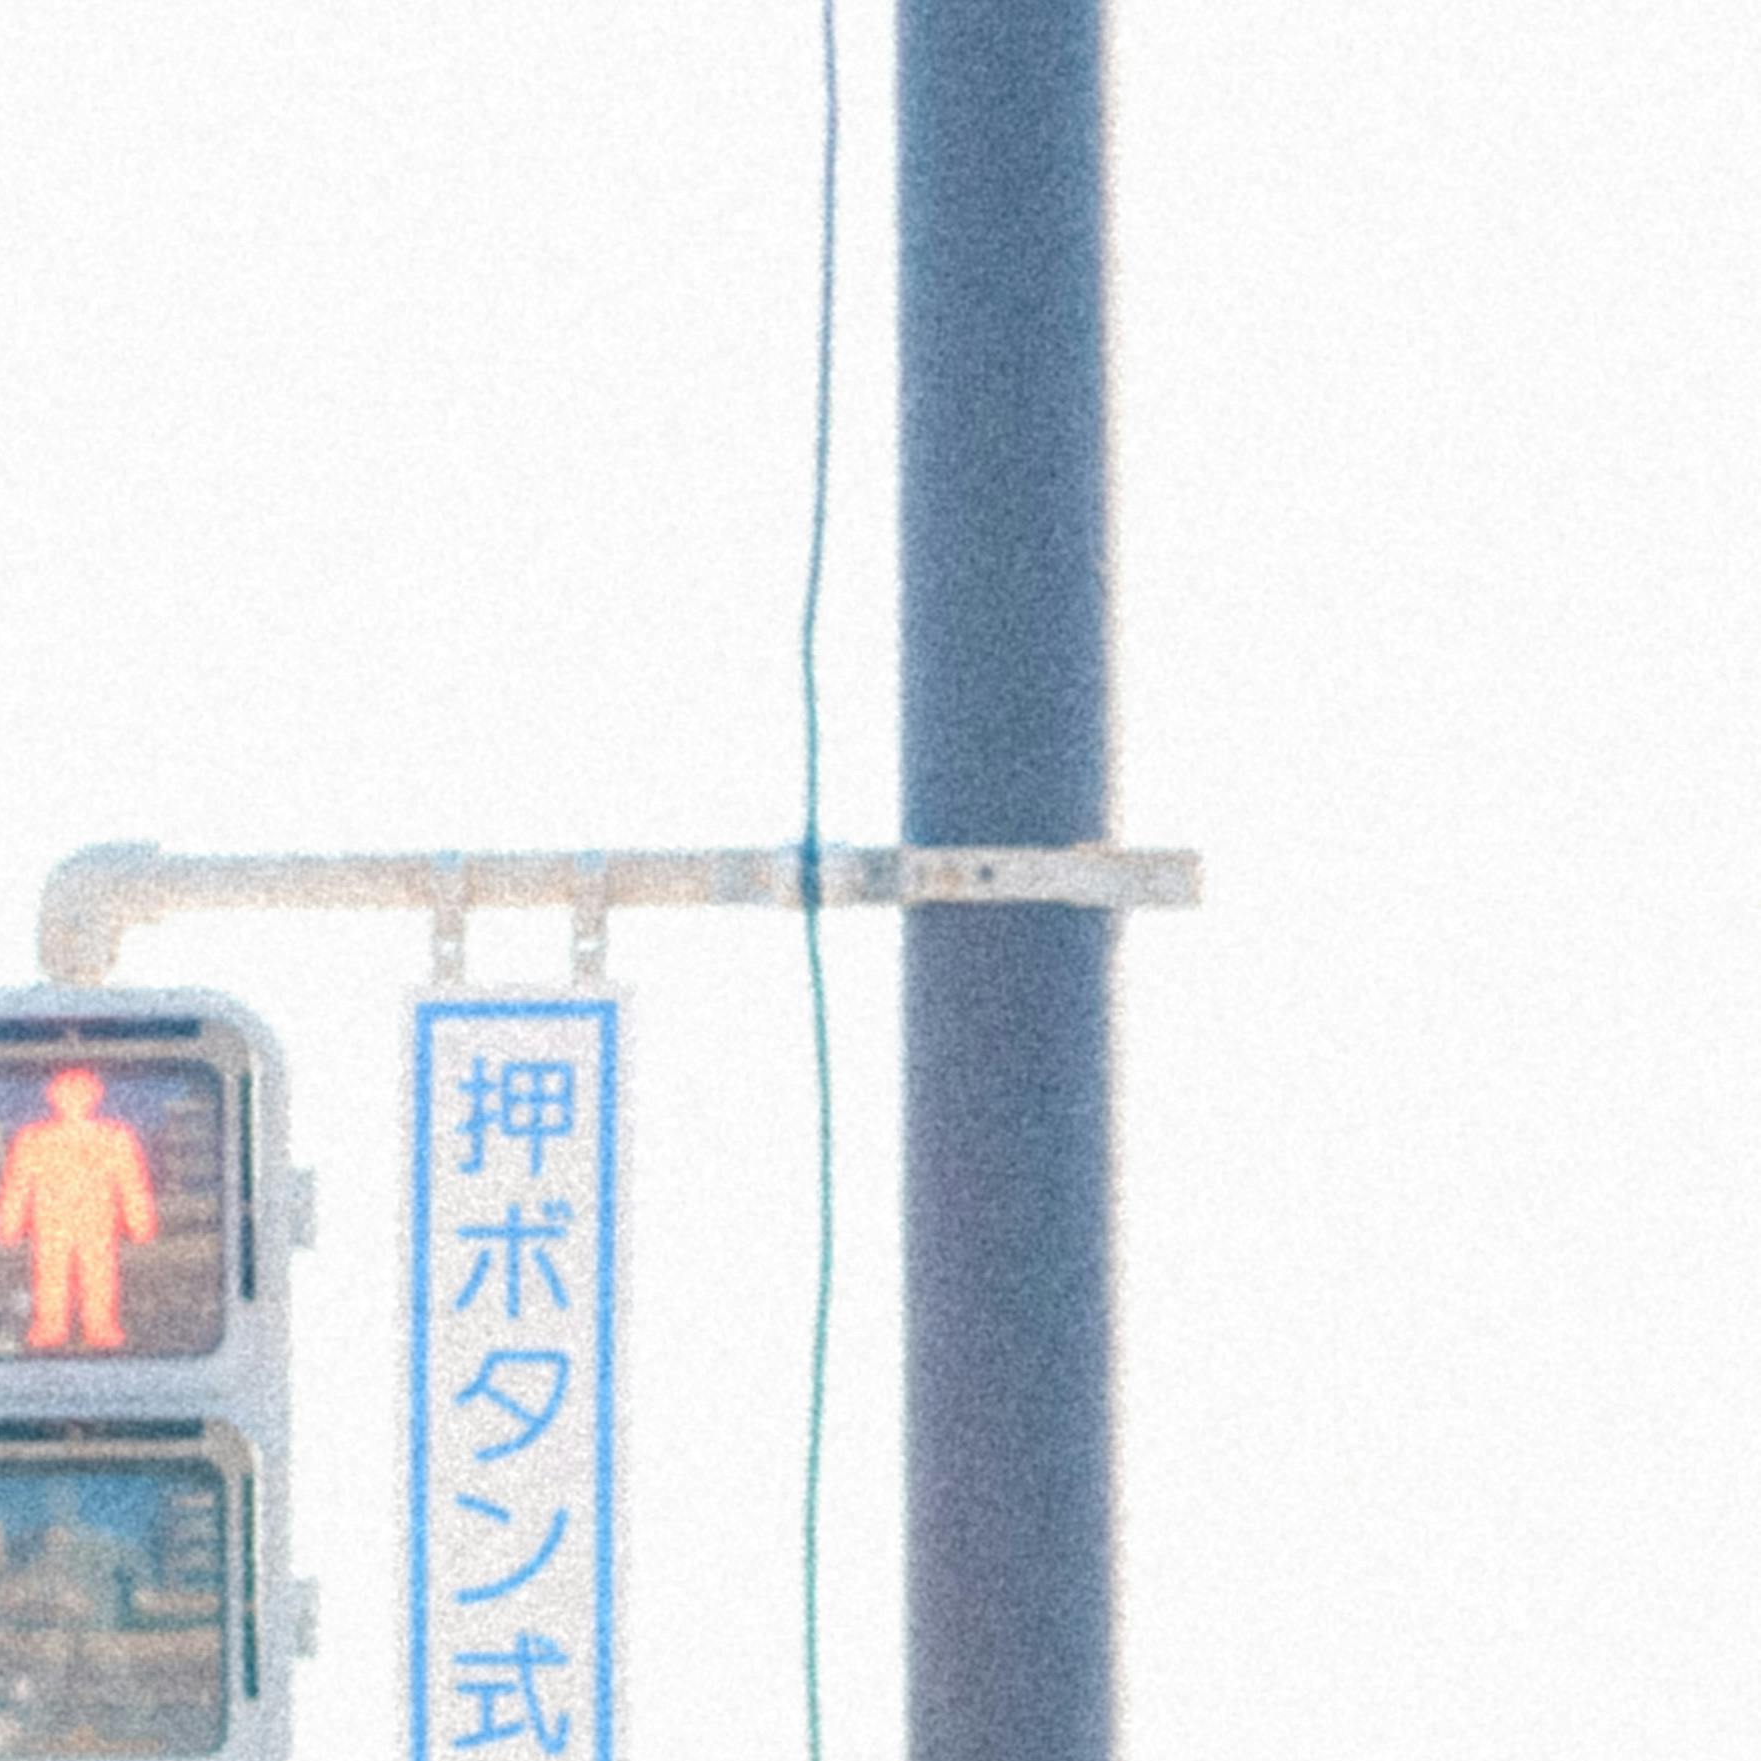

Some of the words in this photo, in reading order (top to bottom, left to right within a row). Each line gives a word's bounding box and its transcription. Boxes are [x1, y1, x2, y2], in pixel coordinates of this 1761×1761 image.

[453, 1056, 575, 1755] 押ボタン式
